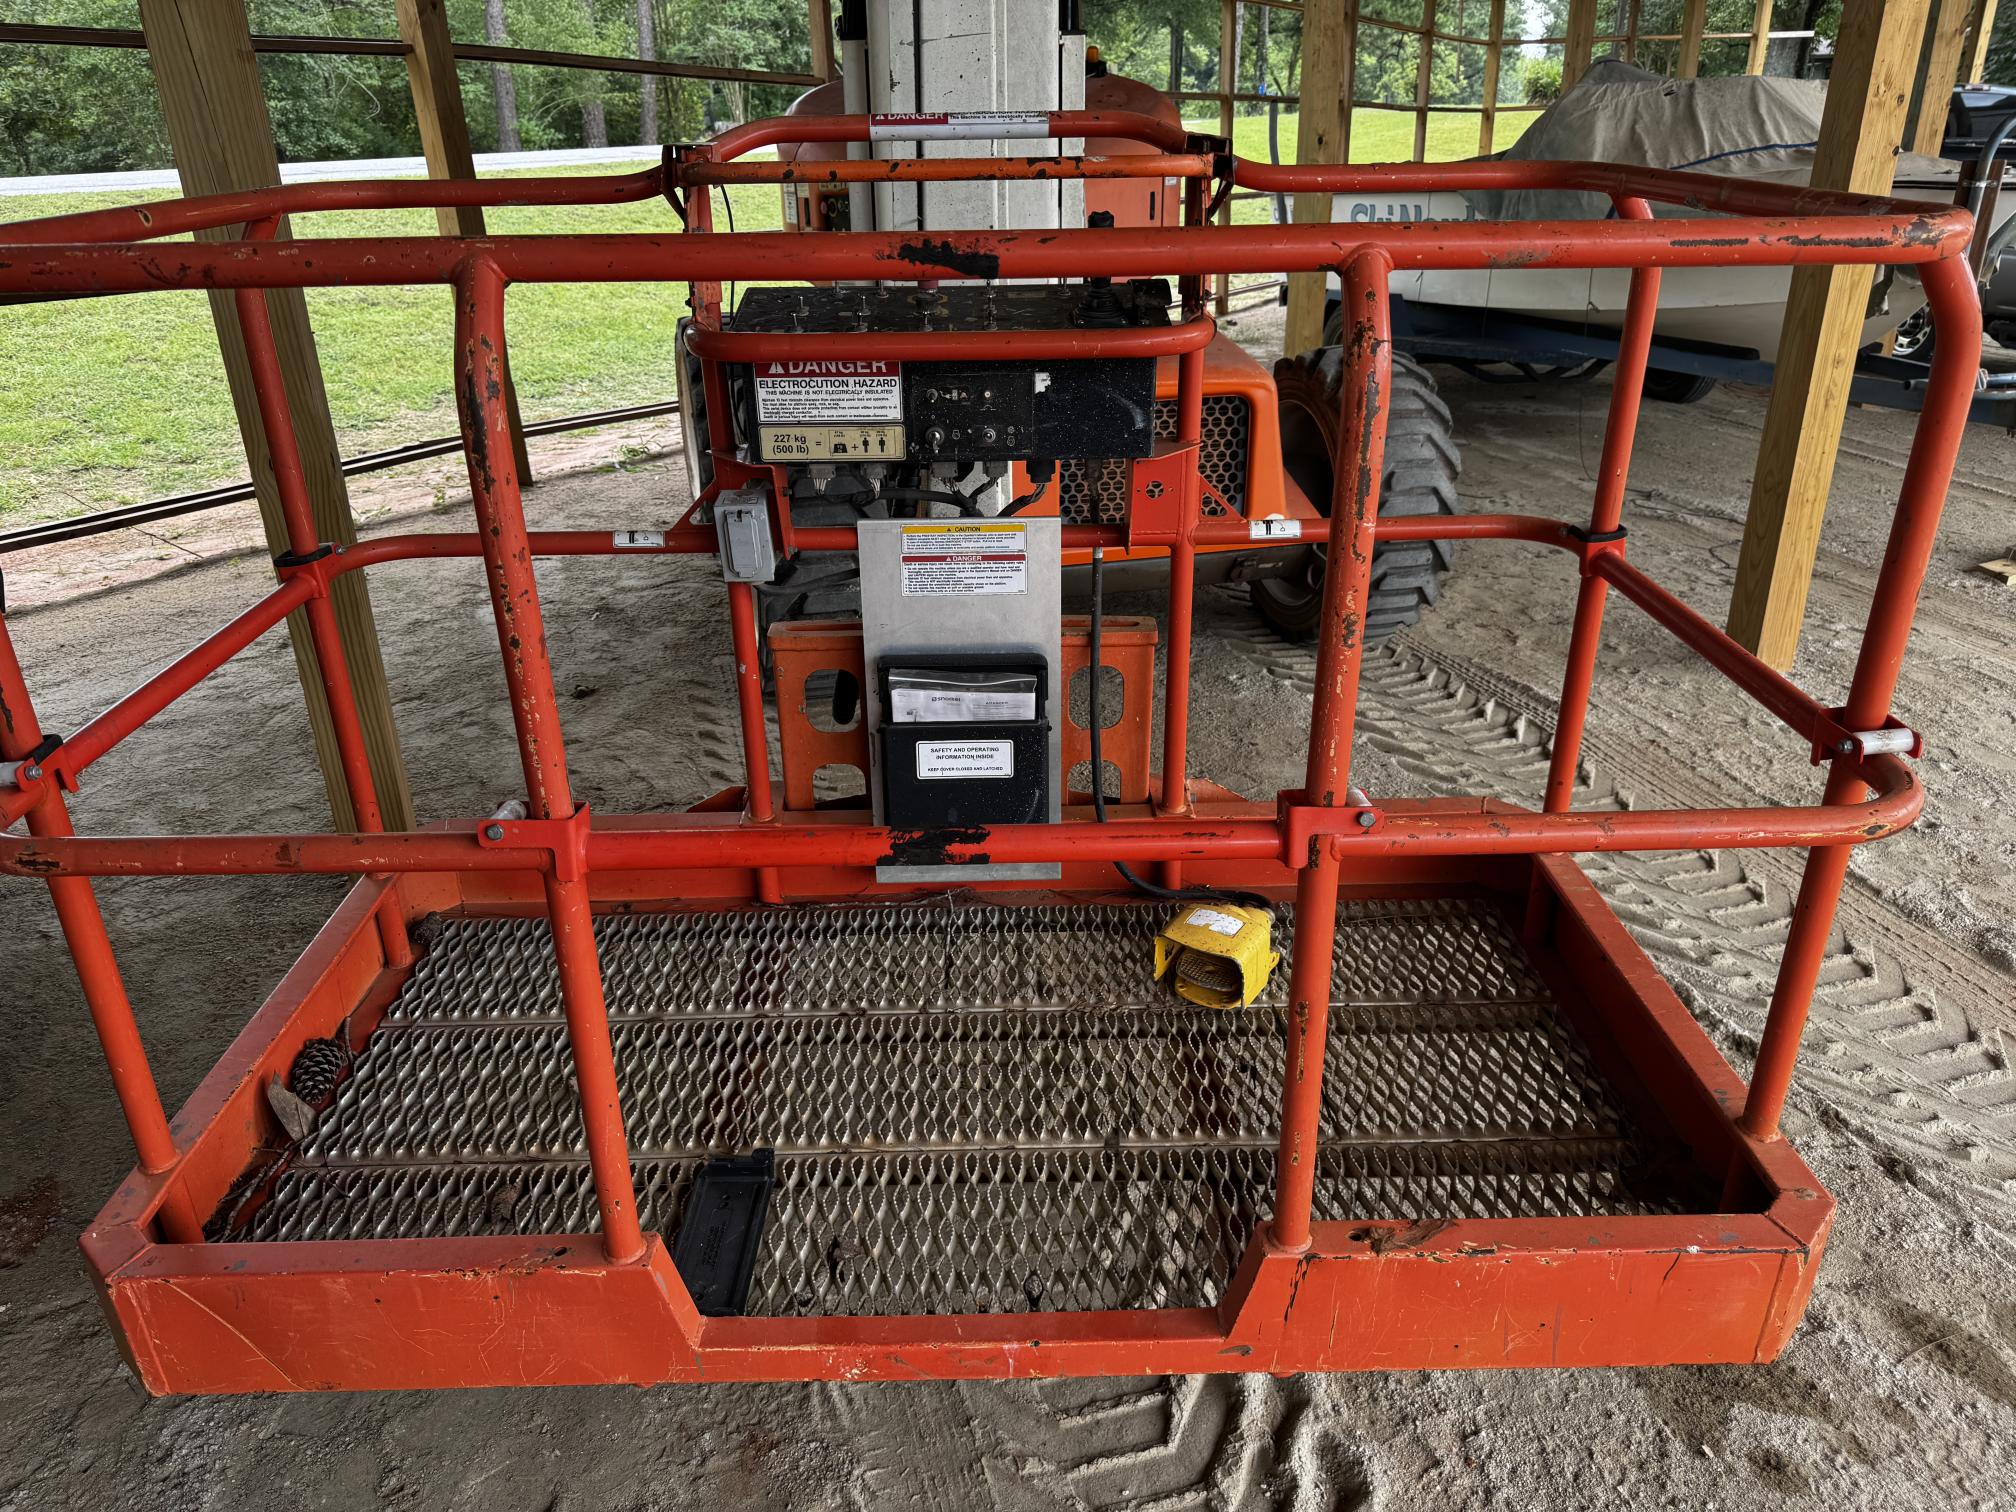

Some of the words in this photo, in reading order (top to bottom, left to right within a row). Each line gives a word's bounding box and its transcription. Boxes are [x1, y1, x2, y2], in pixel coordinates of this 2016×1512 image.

[788, 361, 887, 374] DANGER
[759, 379, 849, 389] ELECTROCUTION
[854, 378, 897, 388] HAZARD
[774, 434, 790, 443] 227
[794, 434, 806, 445] kg
[772, 445, 794, 455] (500
[796, 444, 809, 455] lb)
